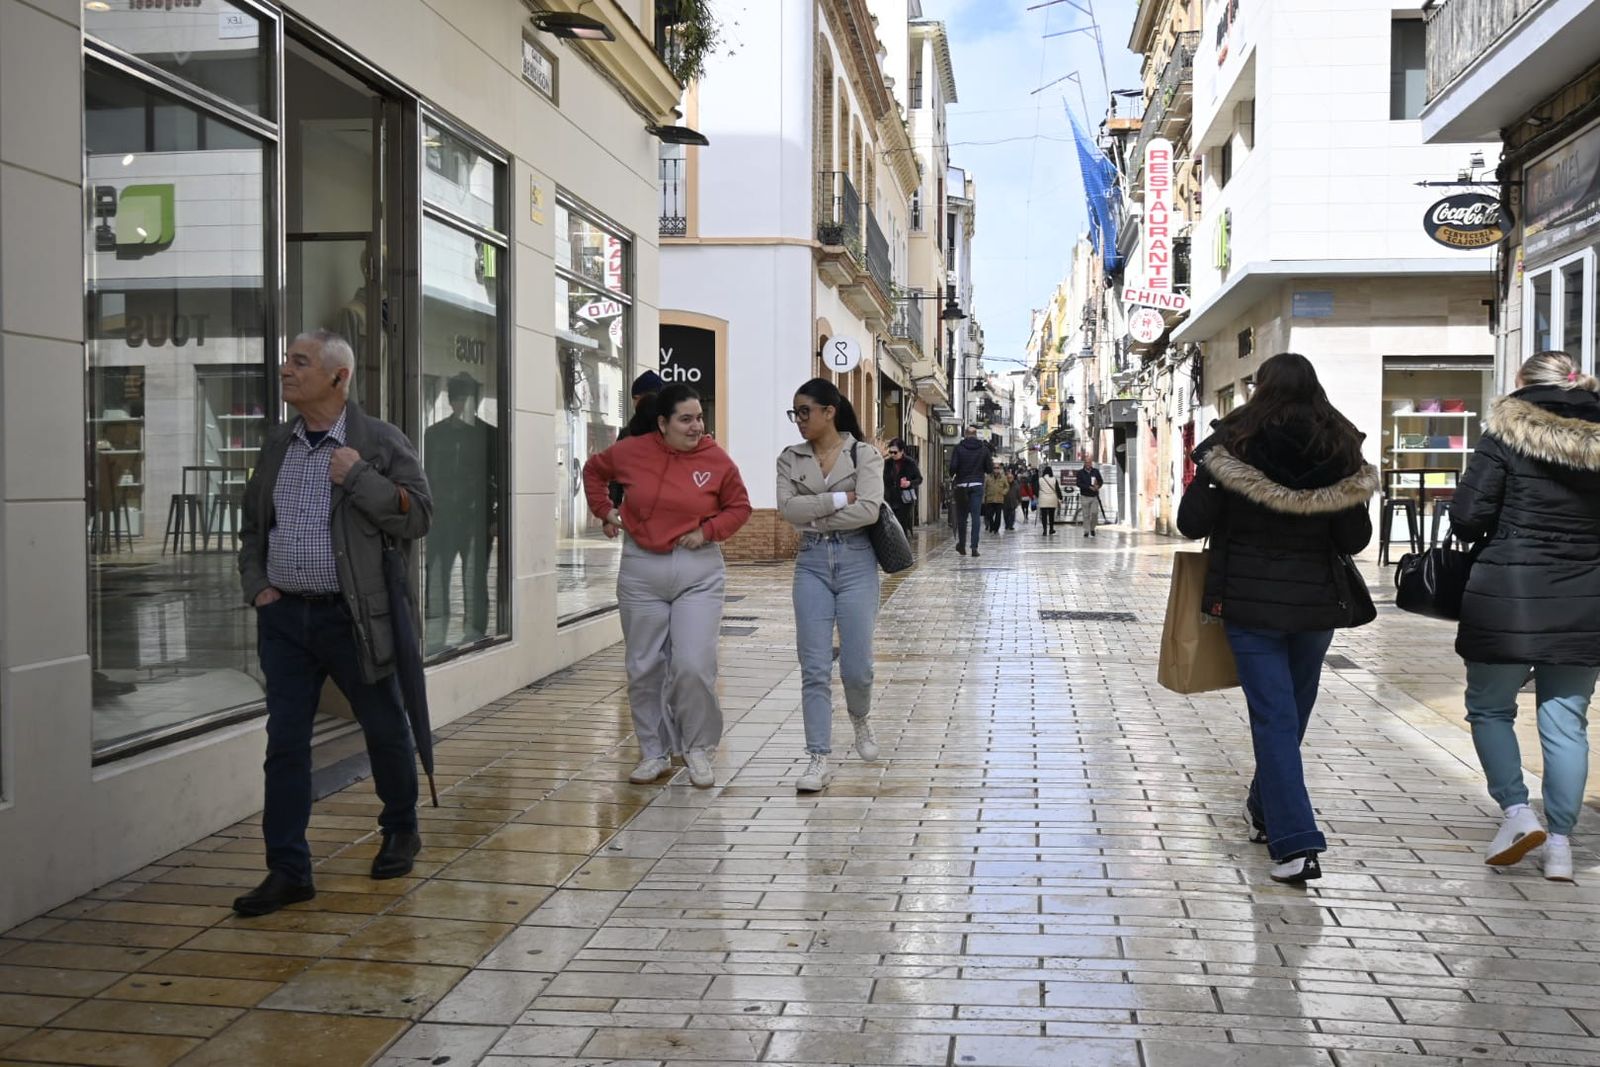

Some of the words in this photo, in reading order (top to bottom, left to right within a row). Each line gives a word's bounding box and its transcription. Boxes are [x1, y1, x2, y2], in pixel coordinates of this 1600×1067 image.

[1149, 150, 1169, 289] RESTAURANTE
[1124, 289, 1186, 309] CHINO
[660, 363, 702, 382] cho
